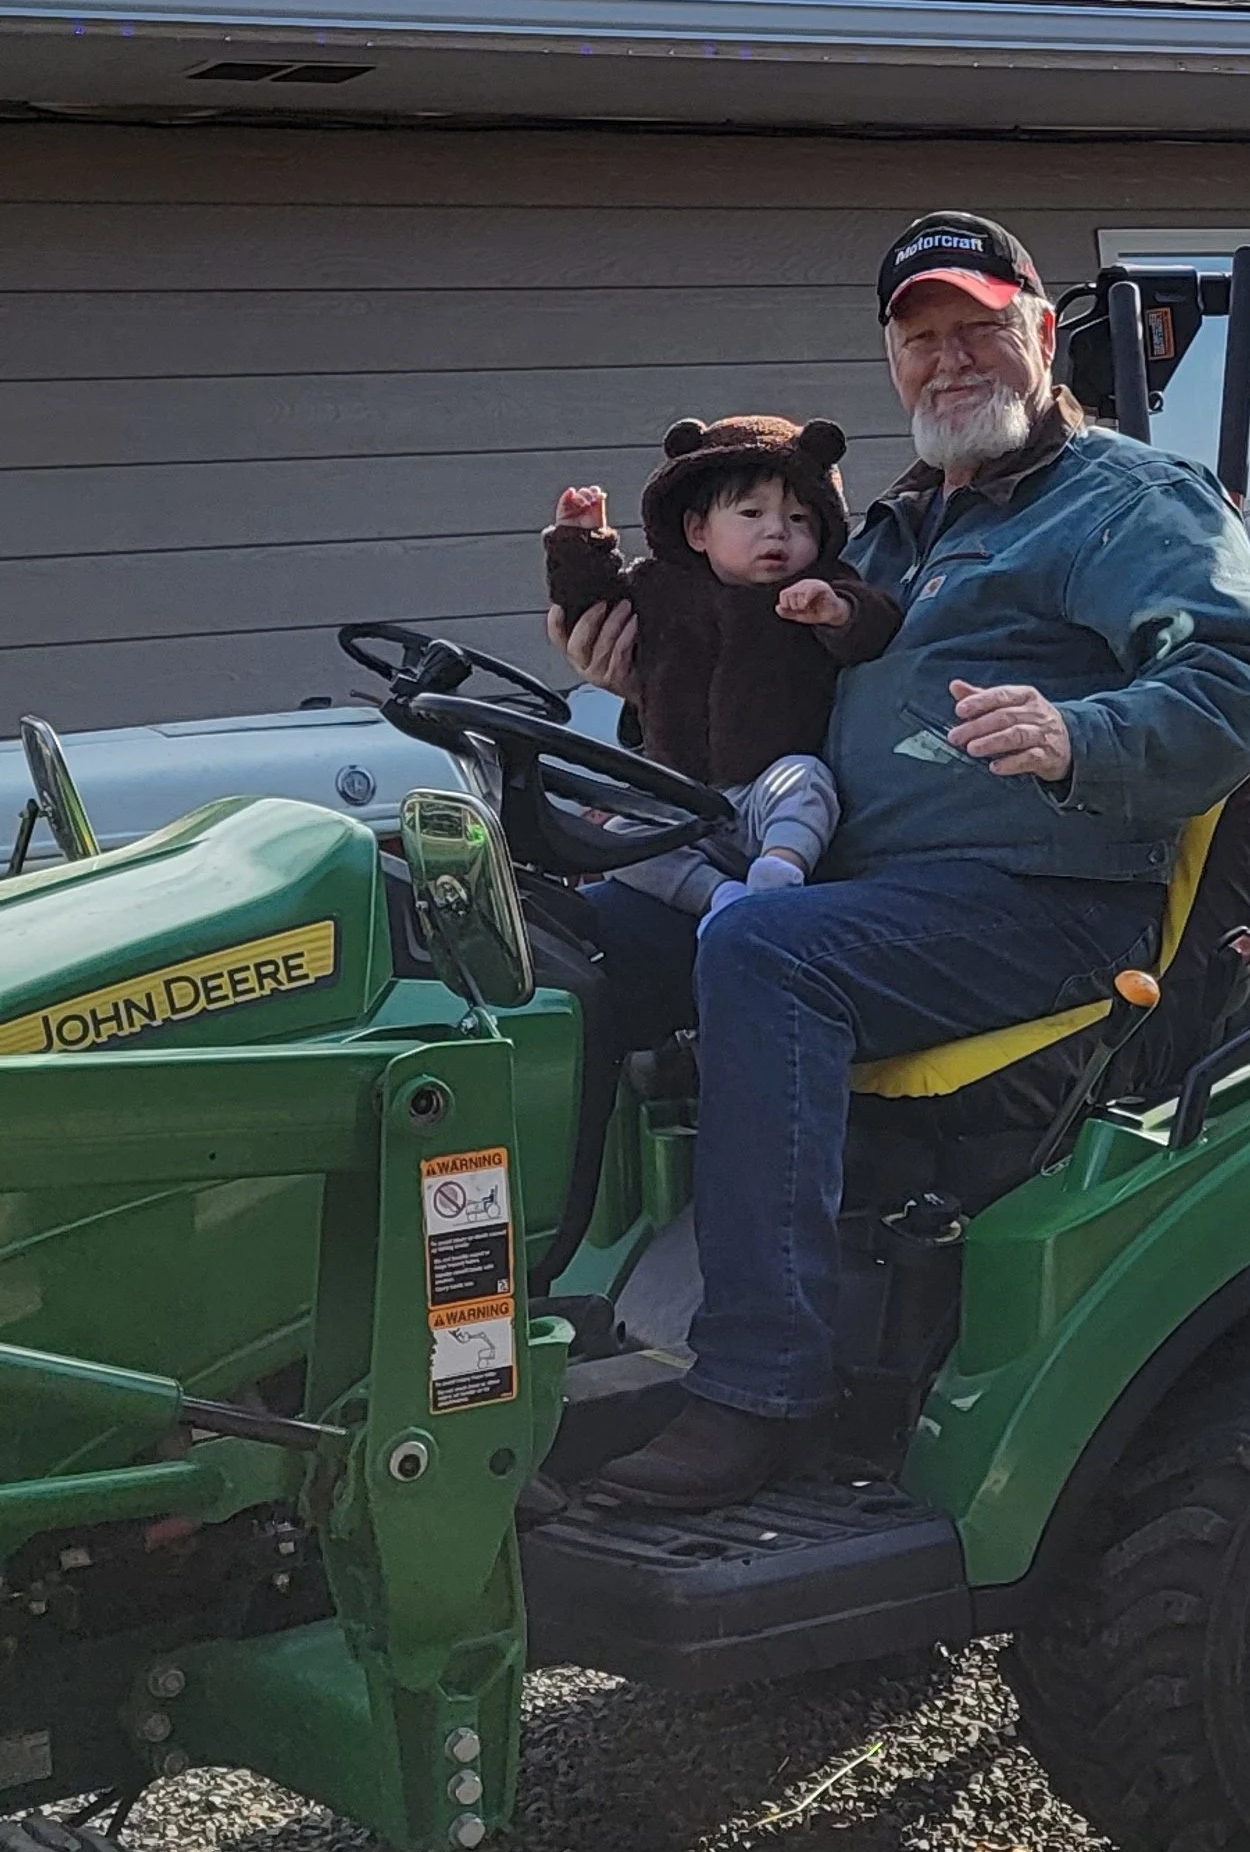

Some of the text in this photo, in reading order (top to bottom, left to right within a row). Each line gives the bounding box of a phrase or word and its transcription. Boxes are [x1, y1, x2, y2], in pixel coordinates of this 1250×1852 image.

[895, 234, 985, 266] Motorcraft
[40, 951, 310, 1050] JOHN DEERE
[436, 1152, 503, 1174] WARNING
[445, 1301, 510, 1325] WARNING
